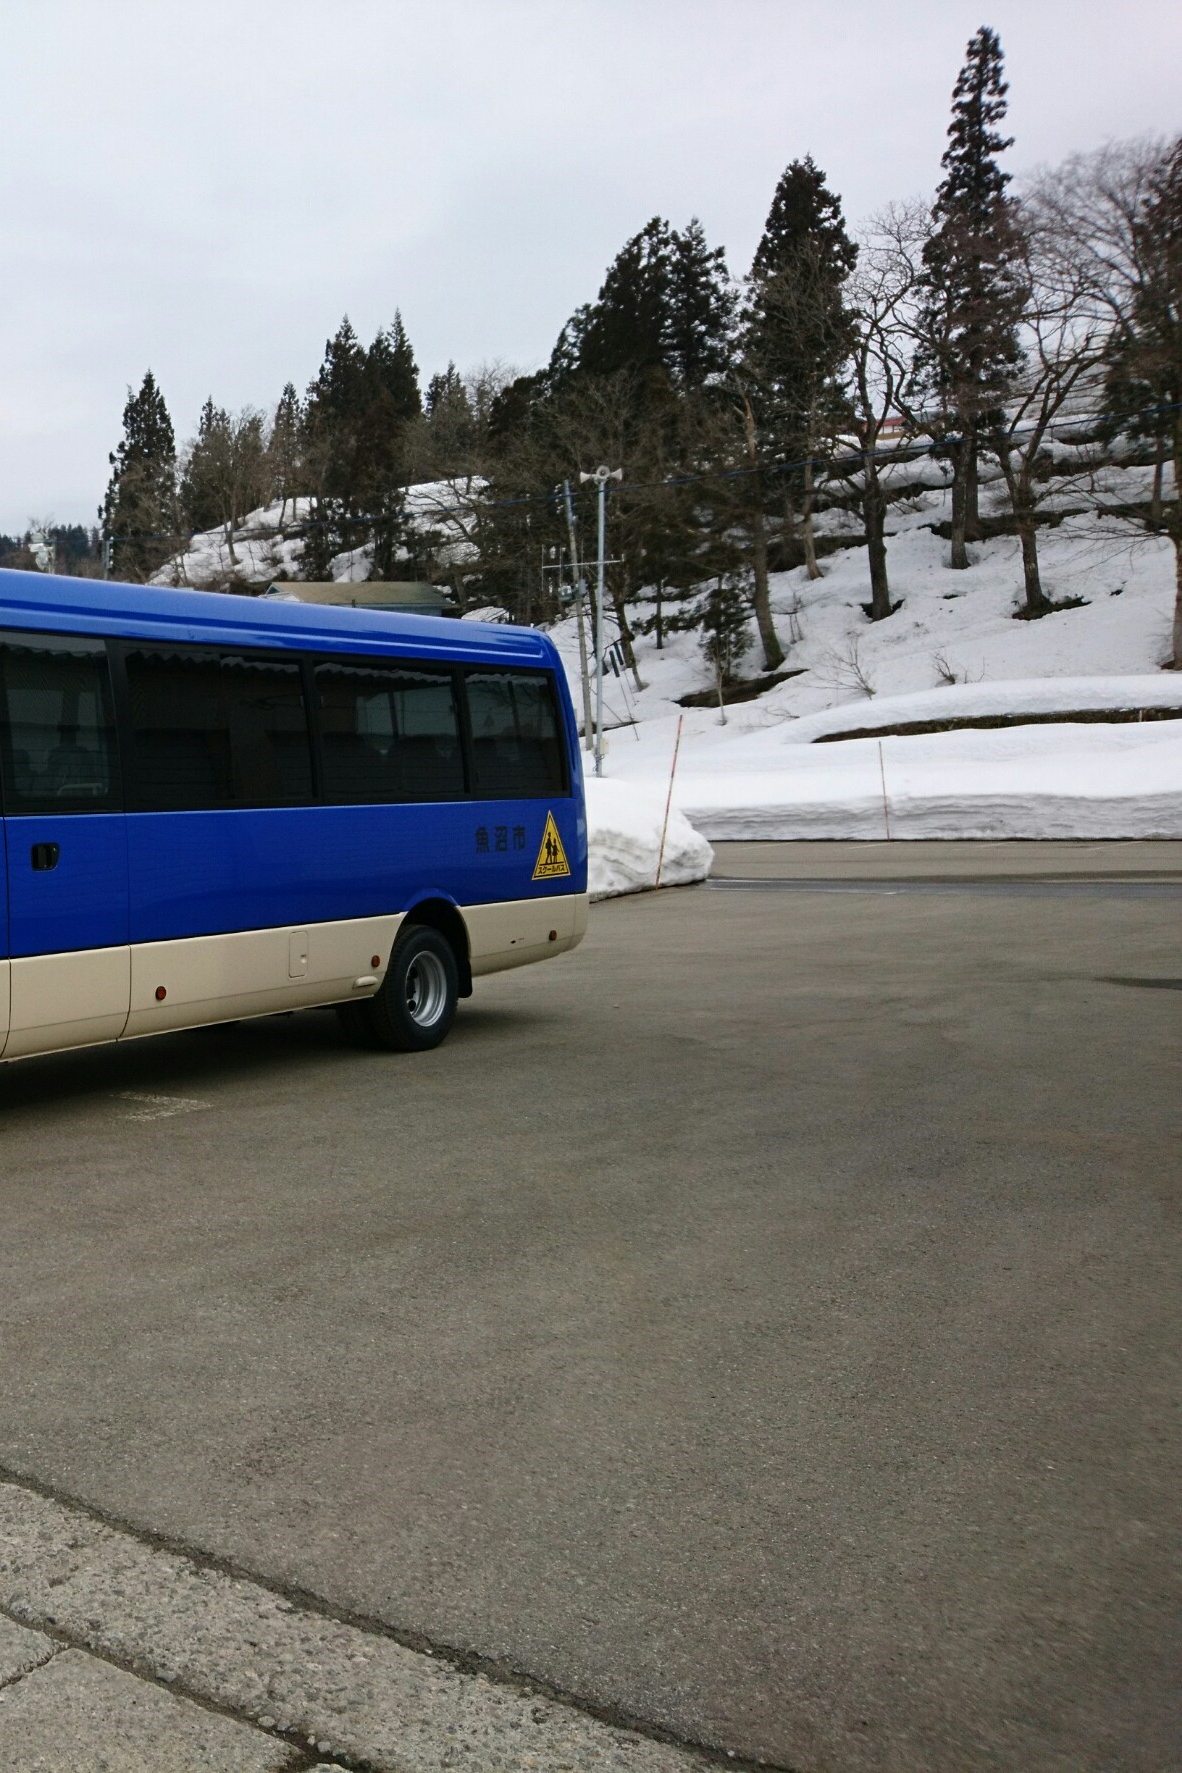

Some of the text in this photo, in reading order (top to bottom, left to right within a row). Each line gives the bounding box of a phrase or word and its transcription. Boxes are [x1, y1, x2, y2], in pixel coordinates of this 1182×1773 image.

[476, 826, 526, 852] 魚沼市
[537, 864, 566, 875] スクールバス
